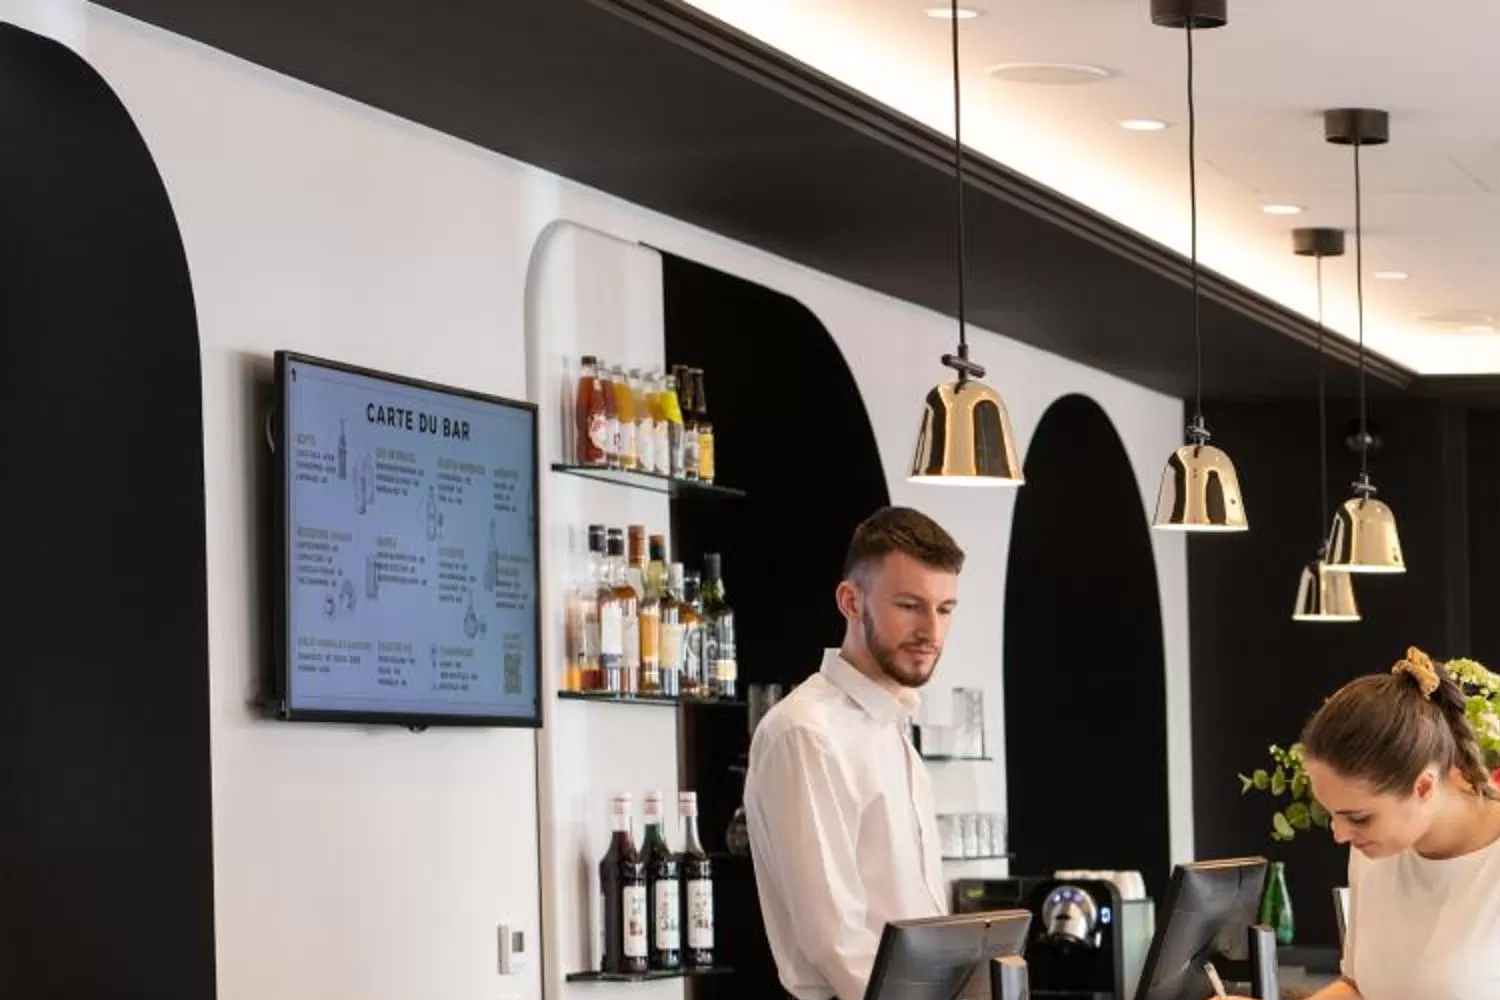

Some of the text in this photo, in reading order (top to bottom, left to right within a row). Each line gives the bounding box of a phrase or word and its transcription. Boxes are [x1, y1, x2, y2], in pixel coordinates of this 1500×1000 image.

[367, 402, 470, 441] CARTE DU BAR
